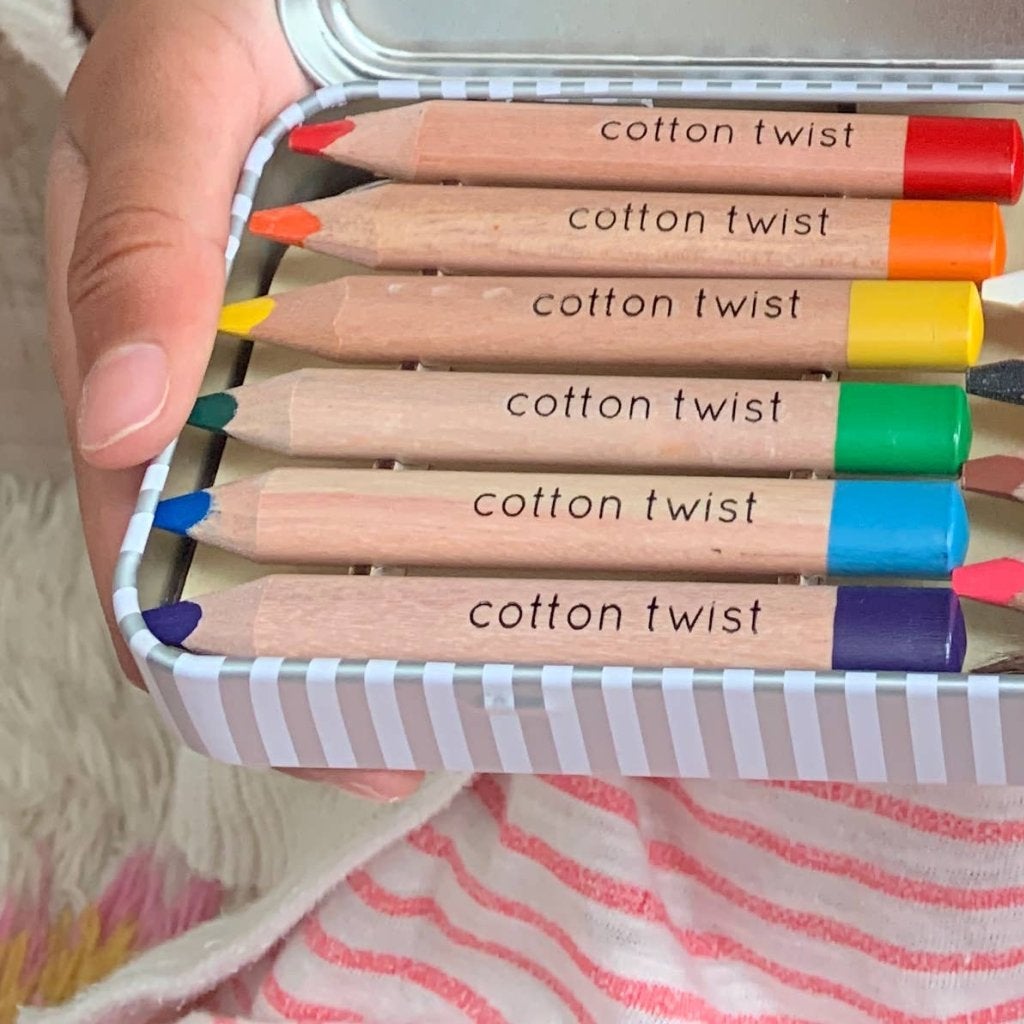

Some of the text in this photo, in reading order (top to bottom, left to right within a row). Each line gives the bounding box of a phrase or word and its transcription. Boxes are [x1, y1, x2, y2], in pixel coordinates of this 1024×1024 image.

[602, 117, 853, 148] cotton twist
[569, 203, 829, 236] cotton twist
[532, 287, 800, 319] cotton twist
[506, 386, 781, 423] cotton twist
[473, 486, 757, 524] cotton twist
[469, 593, 762, 634] cotton twist
